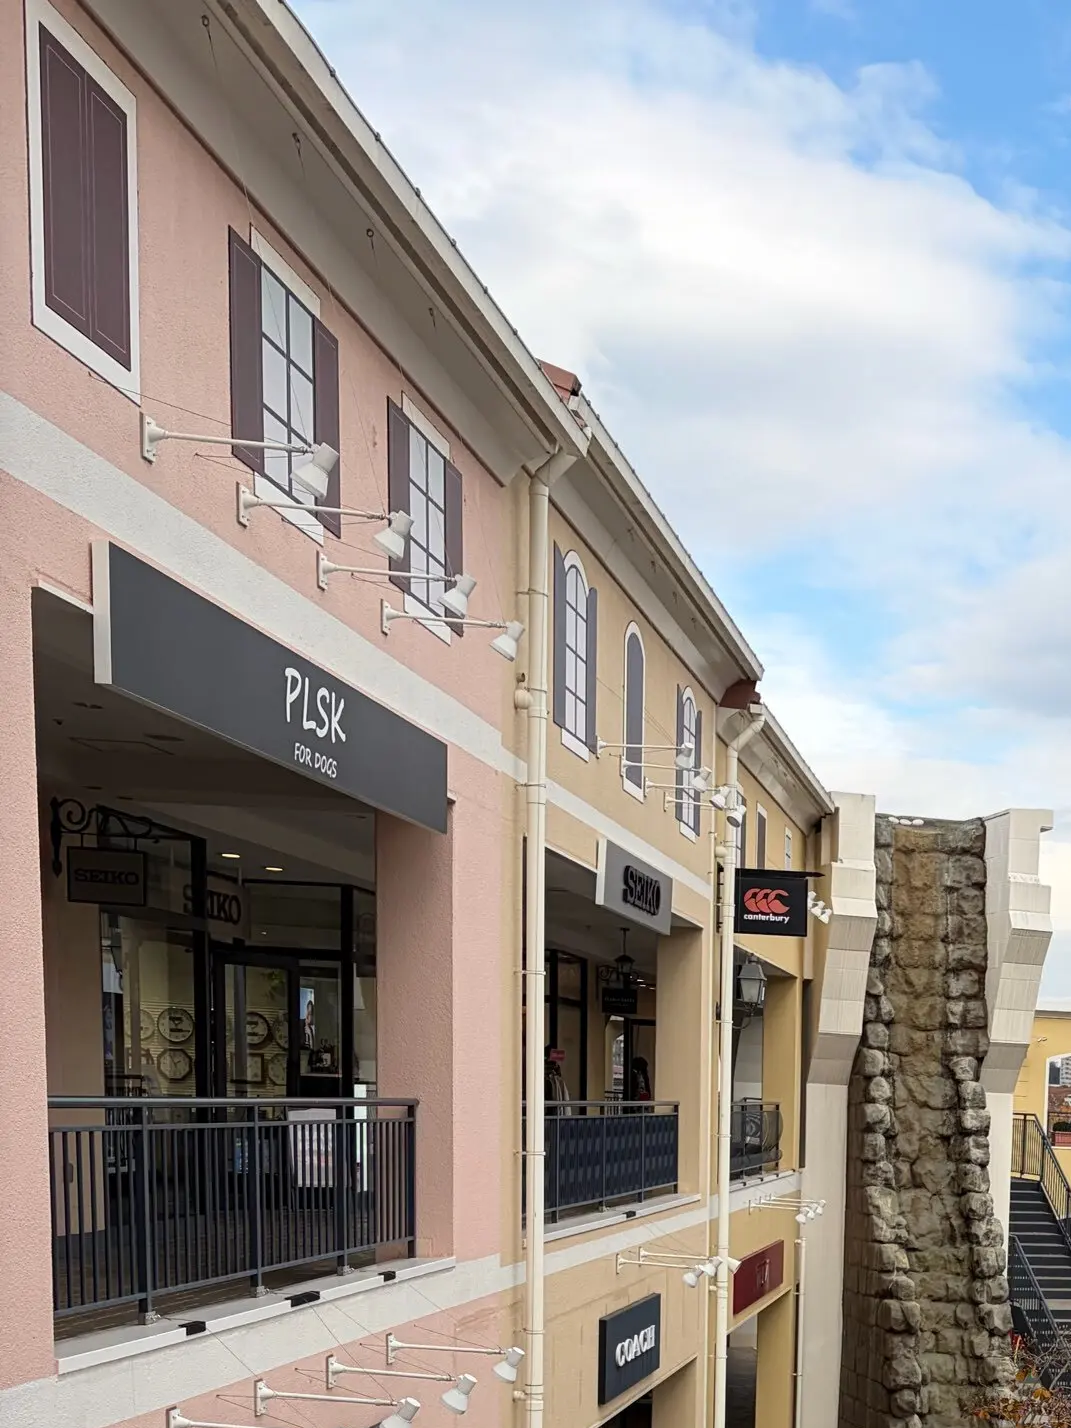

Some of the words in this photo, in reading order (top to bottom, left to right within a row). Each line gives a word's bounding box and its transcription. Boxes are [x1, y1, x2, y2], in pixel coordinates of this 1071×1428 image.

[285, 667, 346, 744] PLSK
[294, 742, 312, 767] FOR
[315, 752, 337, 778] DOGS
[74, 868, 140, 886] SEIKO
[623, 865, 661, 917] SEIKO
[183, 884, 242, 925] SIKO
[743, 912, 790, 924] canterbury
[615, 1324, 656, 1367] COACH
